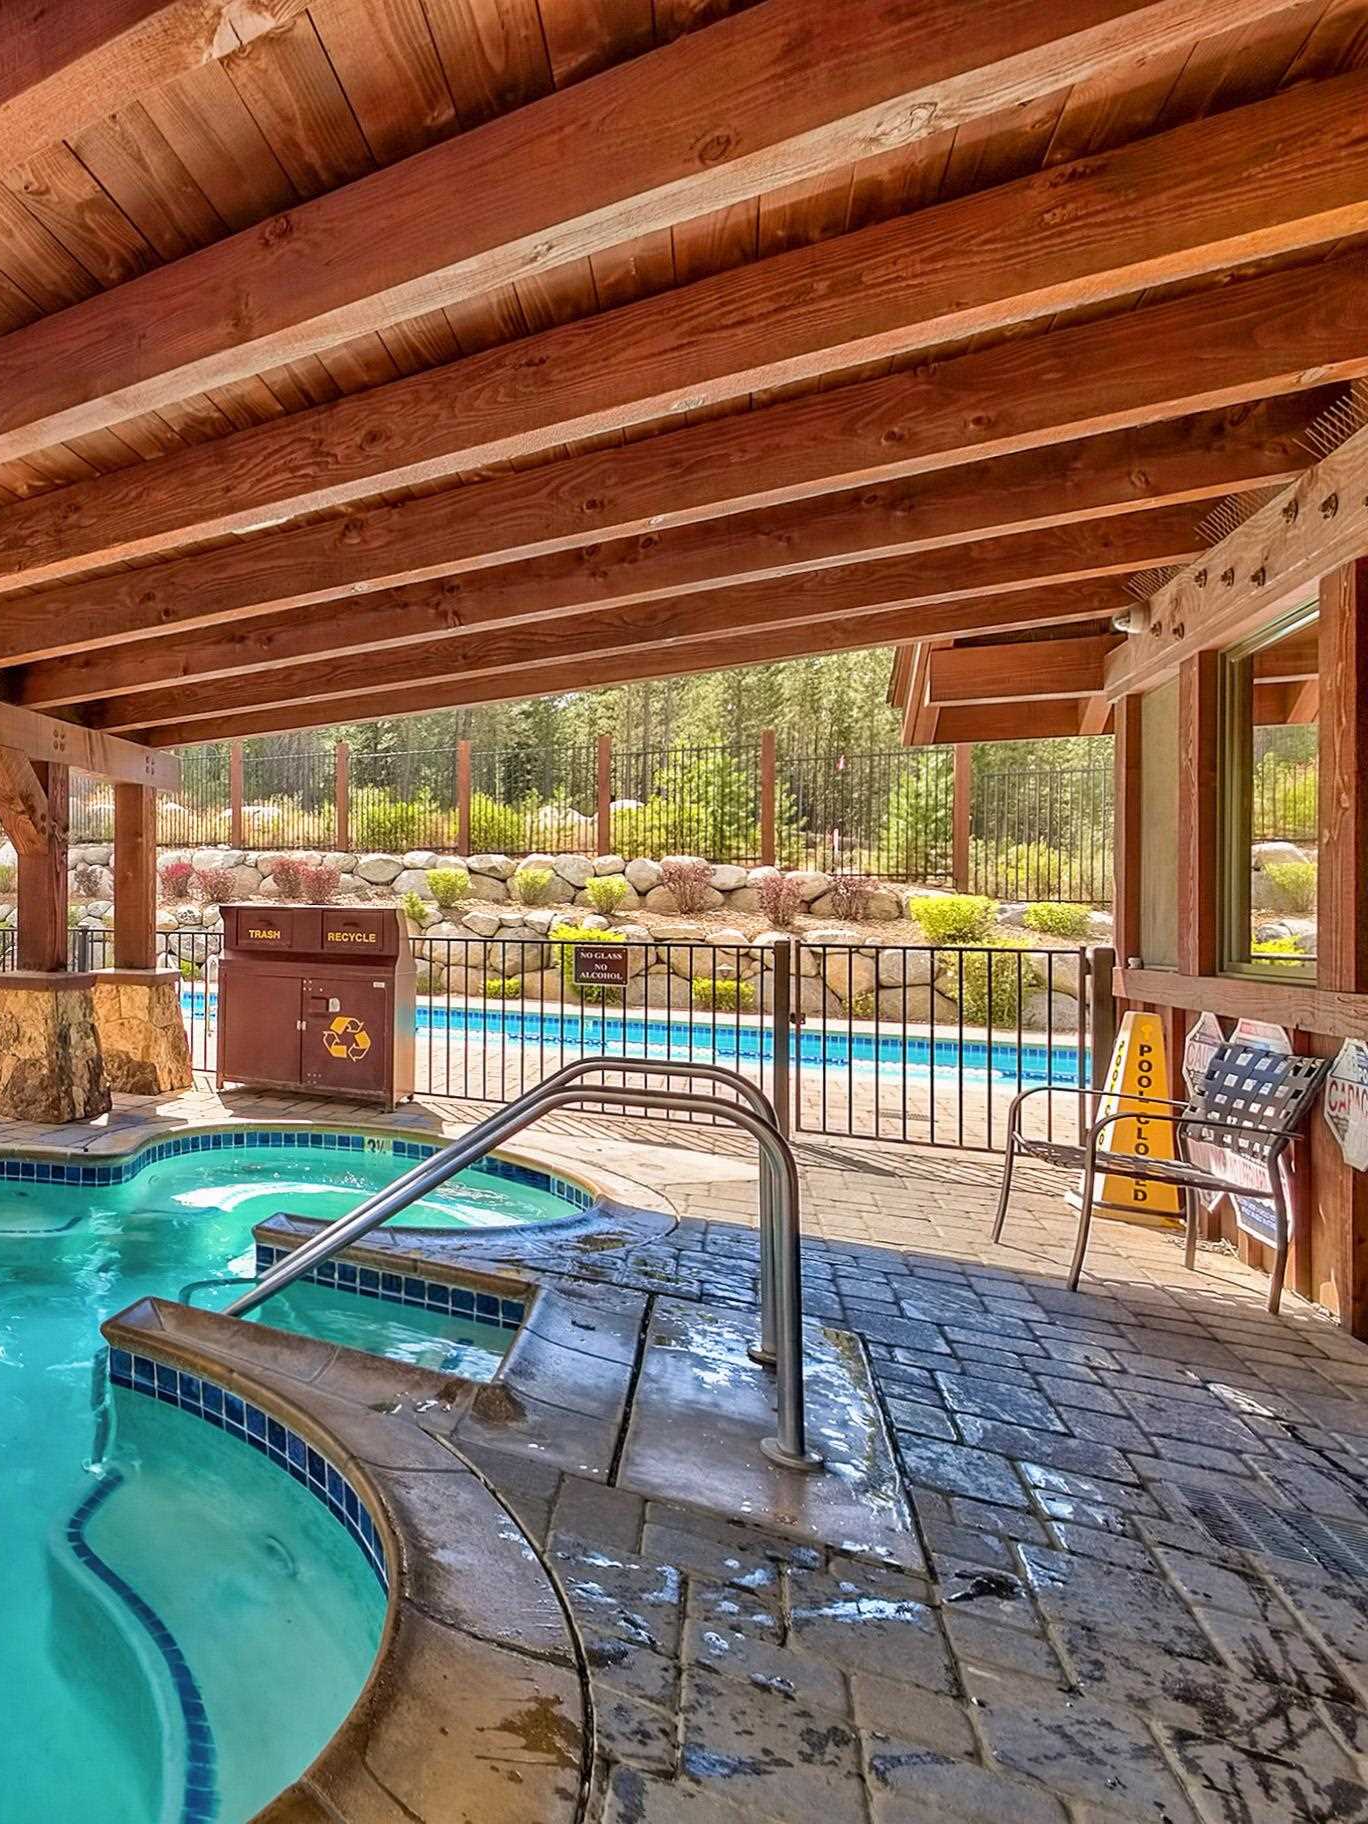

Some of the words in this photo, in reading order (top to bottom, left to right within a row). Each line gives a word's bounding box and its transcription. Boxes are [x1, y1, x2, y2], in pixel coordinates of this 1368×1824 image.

[248, 930, 281, 940] TRASH
[327, 932, 377, 943] RECYCLE
[580, 951, 593, 960] NO
[594, 951, 623, 961] GLASS
[594, 962, 608, 971] NO
[580, 971, 623, 980] ALCOHOL
[1133, 1112, 1150, 1201] CLOED
